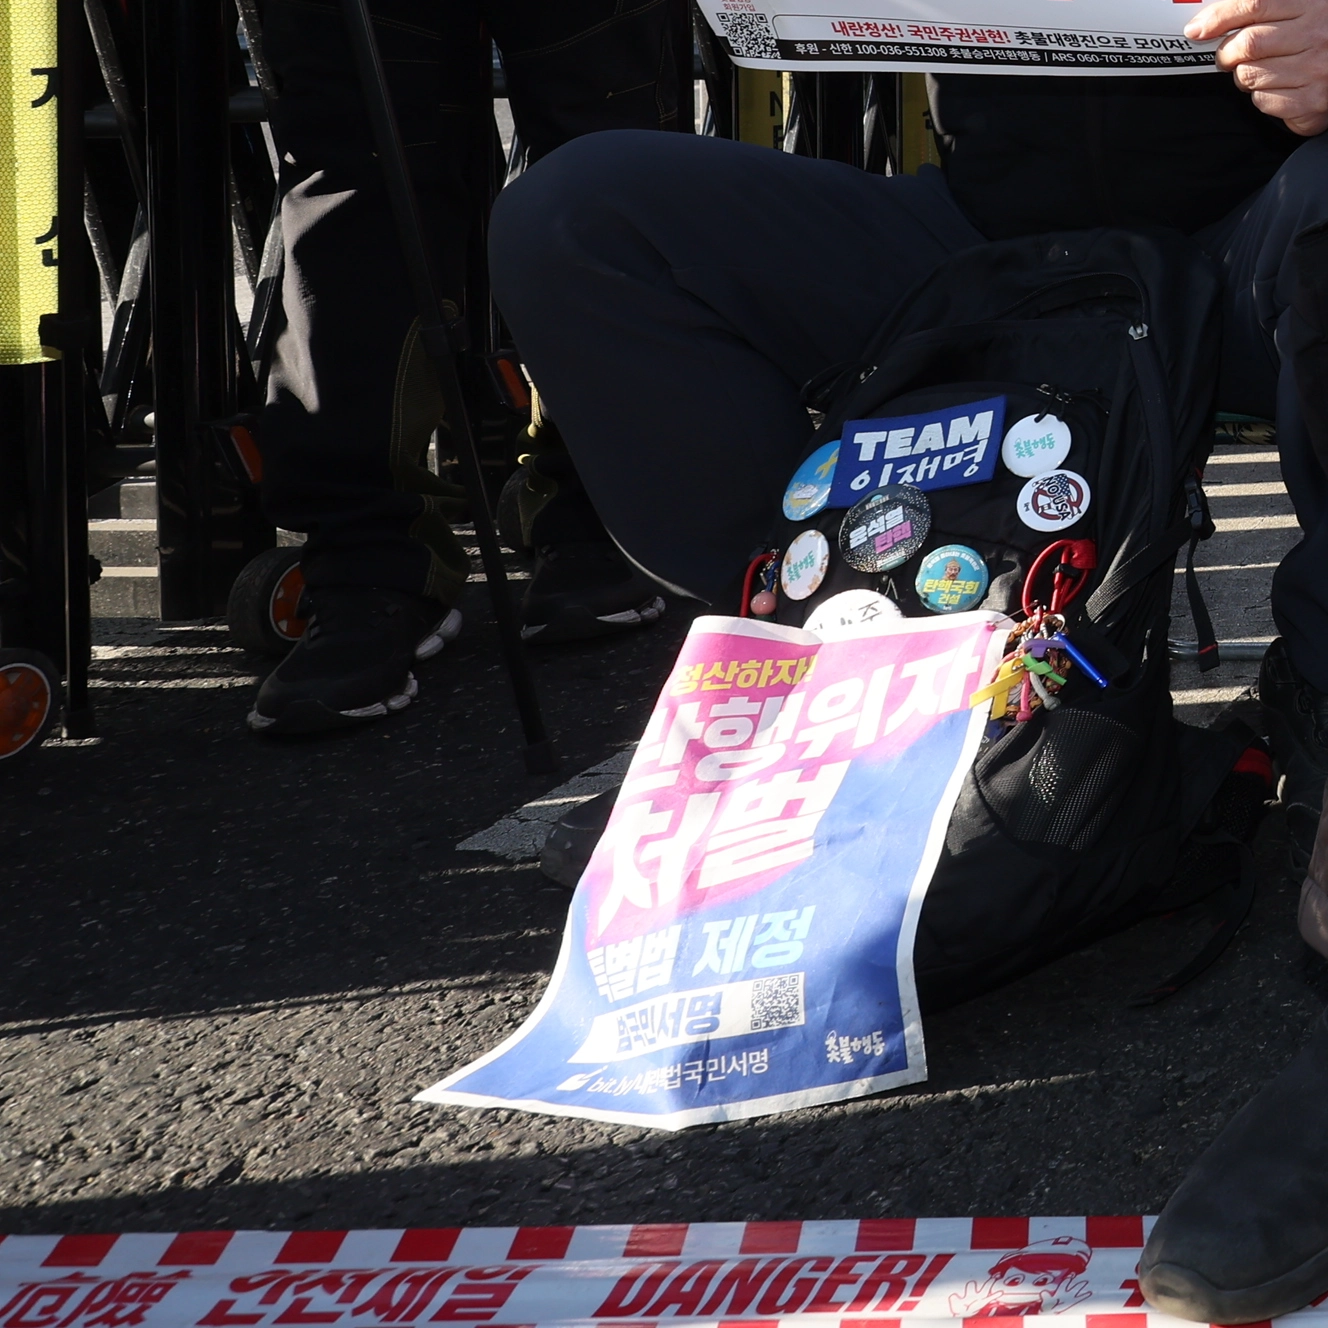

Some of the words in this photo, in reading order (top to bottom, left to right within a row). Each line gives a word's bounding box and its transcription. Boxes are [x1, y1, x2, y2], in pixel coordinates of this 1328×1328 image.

[794, 42, 820, 56] 후원
[829, 42, 853, 56] 신한
[855, 44, 948, 59] 100-036-551308
[949, 48, 1041, 62] 촛불승리전환행동
[1051, 53, 1076, 63] ARS
[830, 20, 904, 38] 내란청산!
[907, 23, 1011, 45] 국민주권실현!
[1014, 30, 1132, 49] 촛불대행진으로
[1133, 37, 1193, 52] 모이자!
[853, 410, 994, 461] TEAM
[1014, 432, 1056, 458] 촛불행동
[850, 438, 989, 491] 이재명
[849, 506, 904, 549] 윤석열
[874, 520, 912, 554] 탄핵
[923, 579, 980, 594] 탄핵국회
[598, 760, 851, 937] 처벌
[587, 924, 682, 1003] 특별법
[692, 905, 816, 977] 제정
[616, 991, 722, 1053] 범국민서명
[825, 1030, 886, 1065] 촛불행동
[0, 1270, 193, 1328] 危險
[592, 1252, 956, 1318] DANGER!
